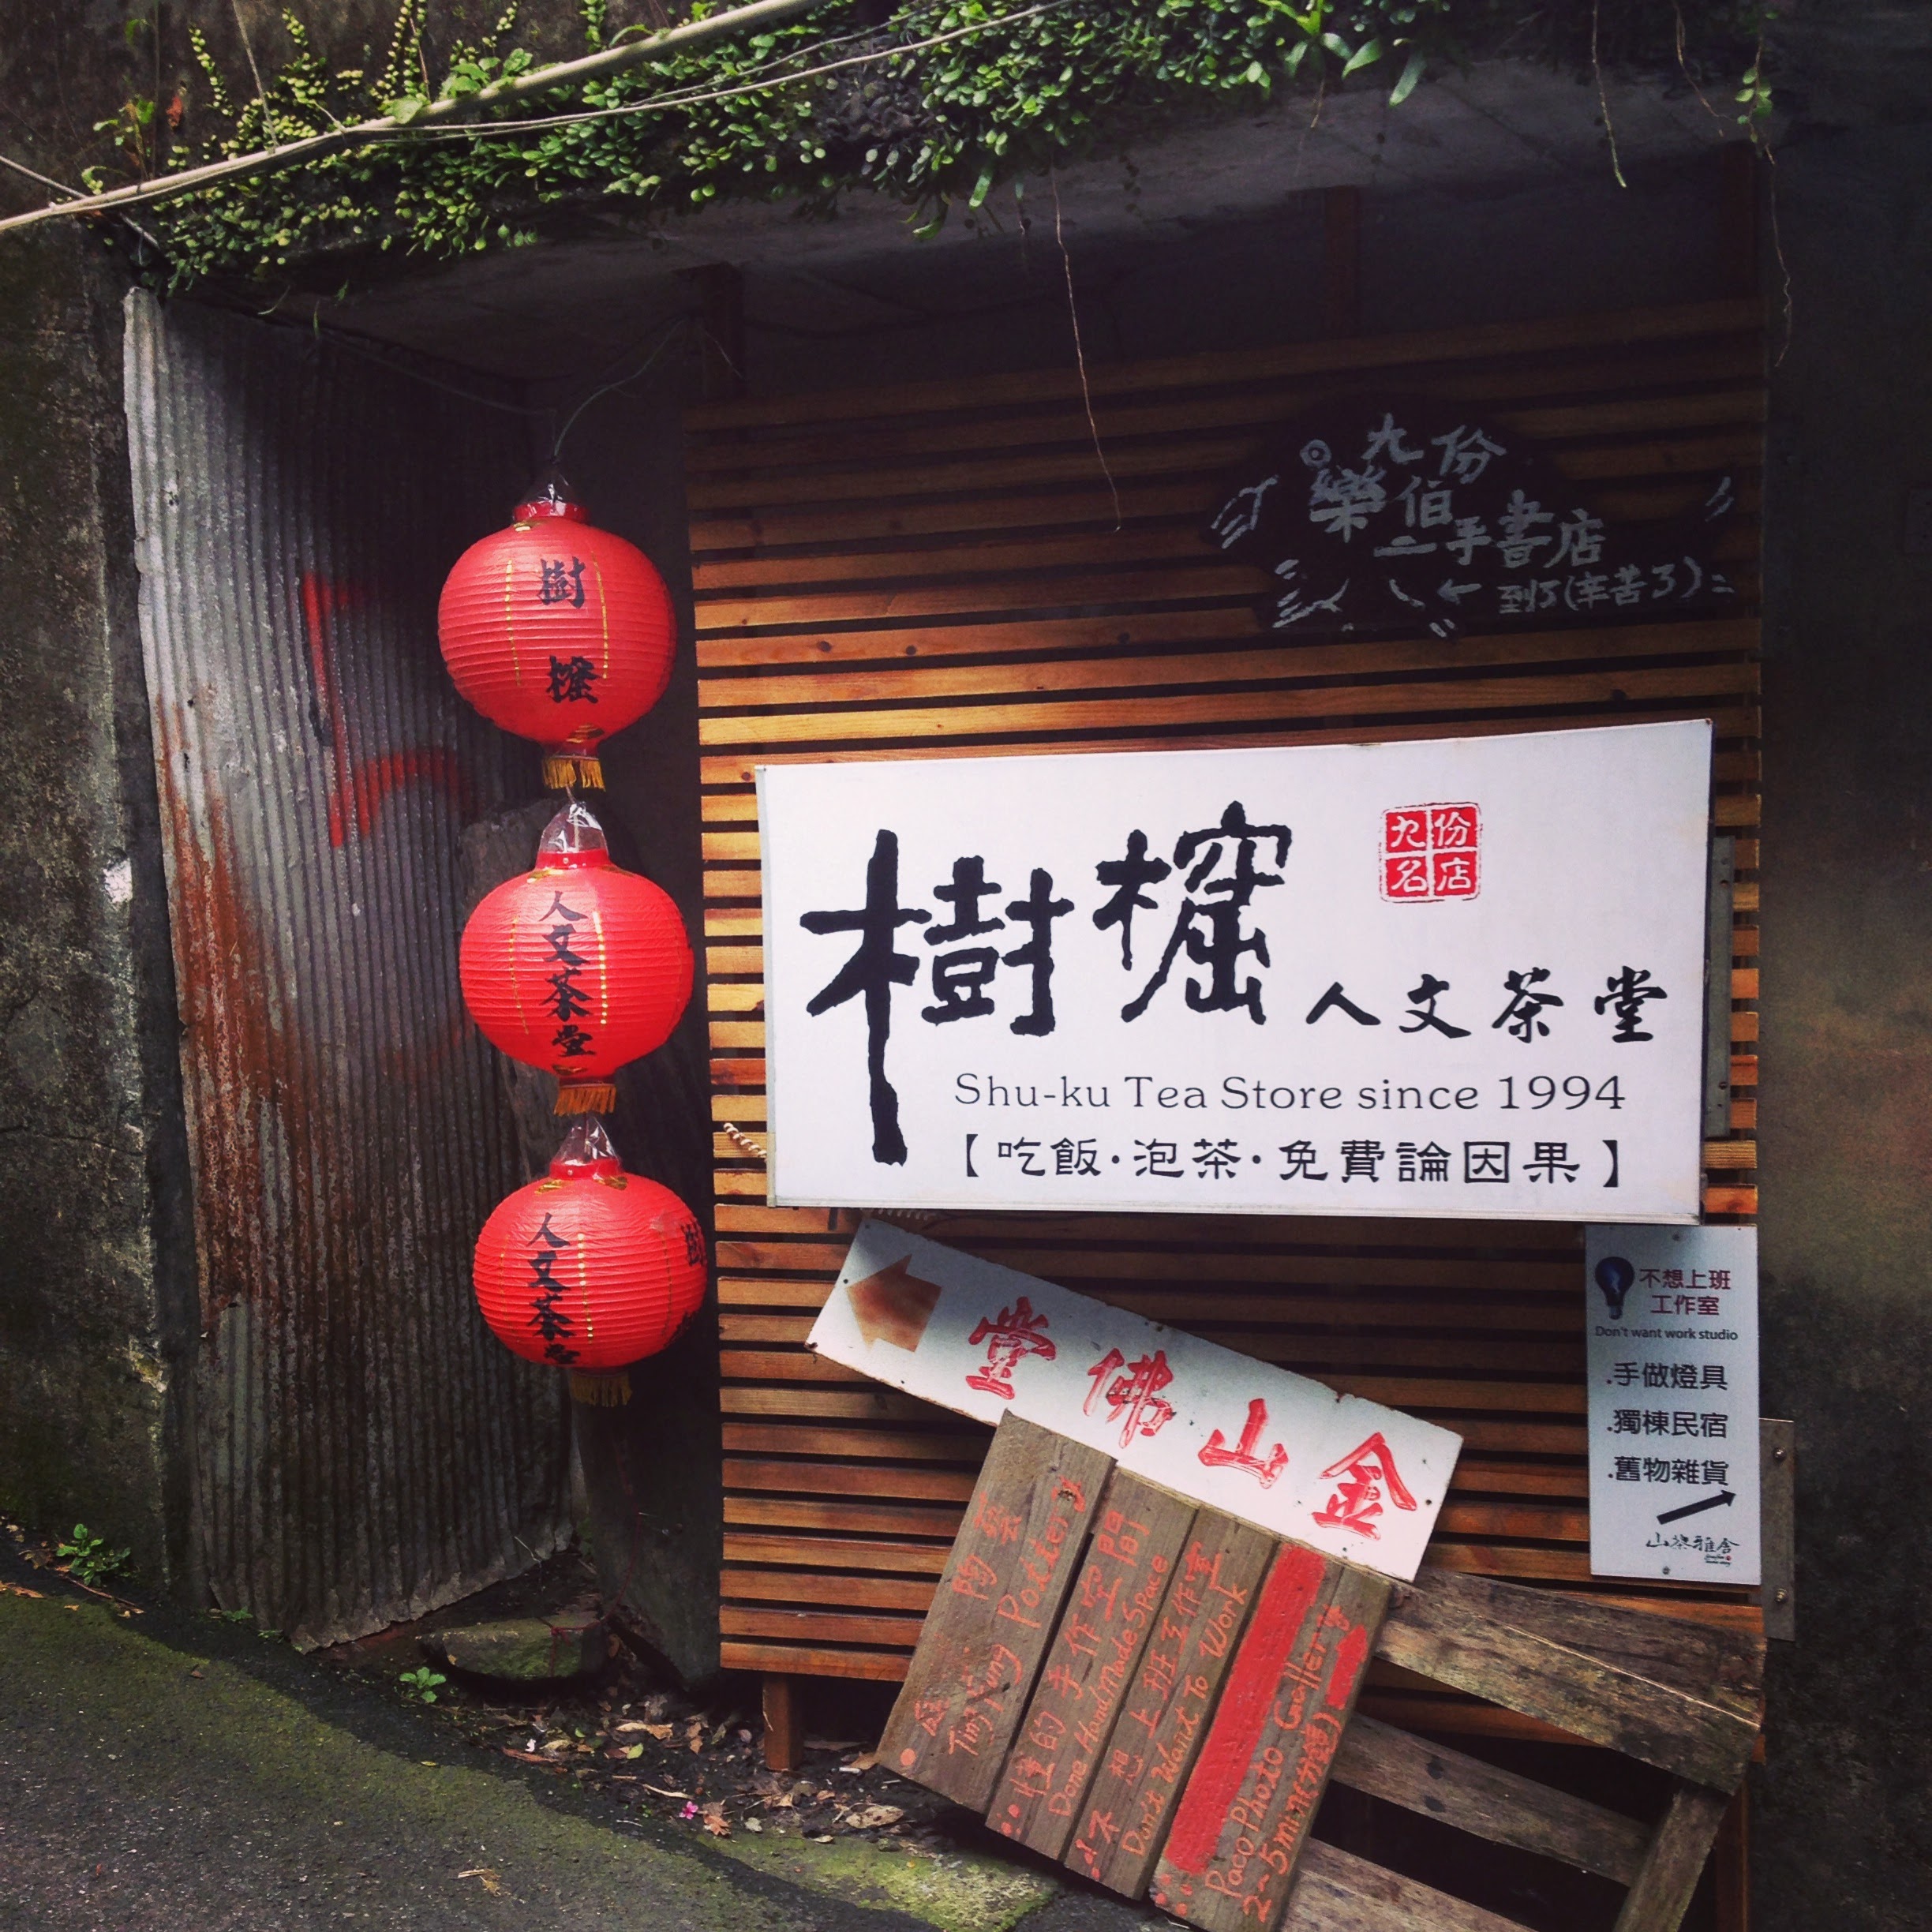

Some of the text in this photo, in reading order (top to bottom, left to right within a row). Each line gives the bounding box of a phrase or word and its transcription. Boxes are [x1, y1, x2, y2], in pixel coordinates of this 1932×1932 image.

[1361, 413, 1507, 485] 九份
[1373, 489, 1607, 569] 二手書店
[538, 889, 597, 1058] 人文茶堂
[1305, 965, 1668, 1044] 人文茶堂
[955, 1073, 1626, 1110] Shu-ku Tea Store since 1994
[1638, 1268, 1732, 1290] 不想上班
[1650, 1294, 1720, 1316] 工作室
[1595, 1325, 1739, 1341] Don't want work studio
[1230, 1747, 1283, 1825] Photo
